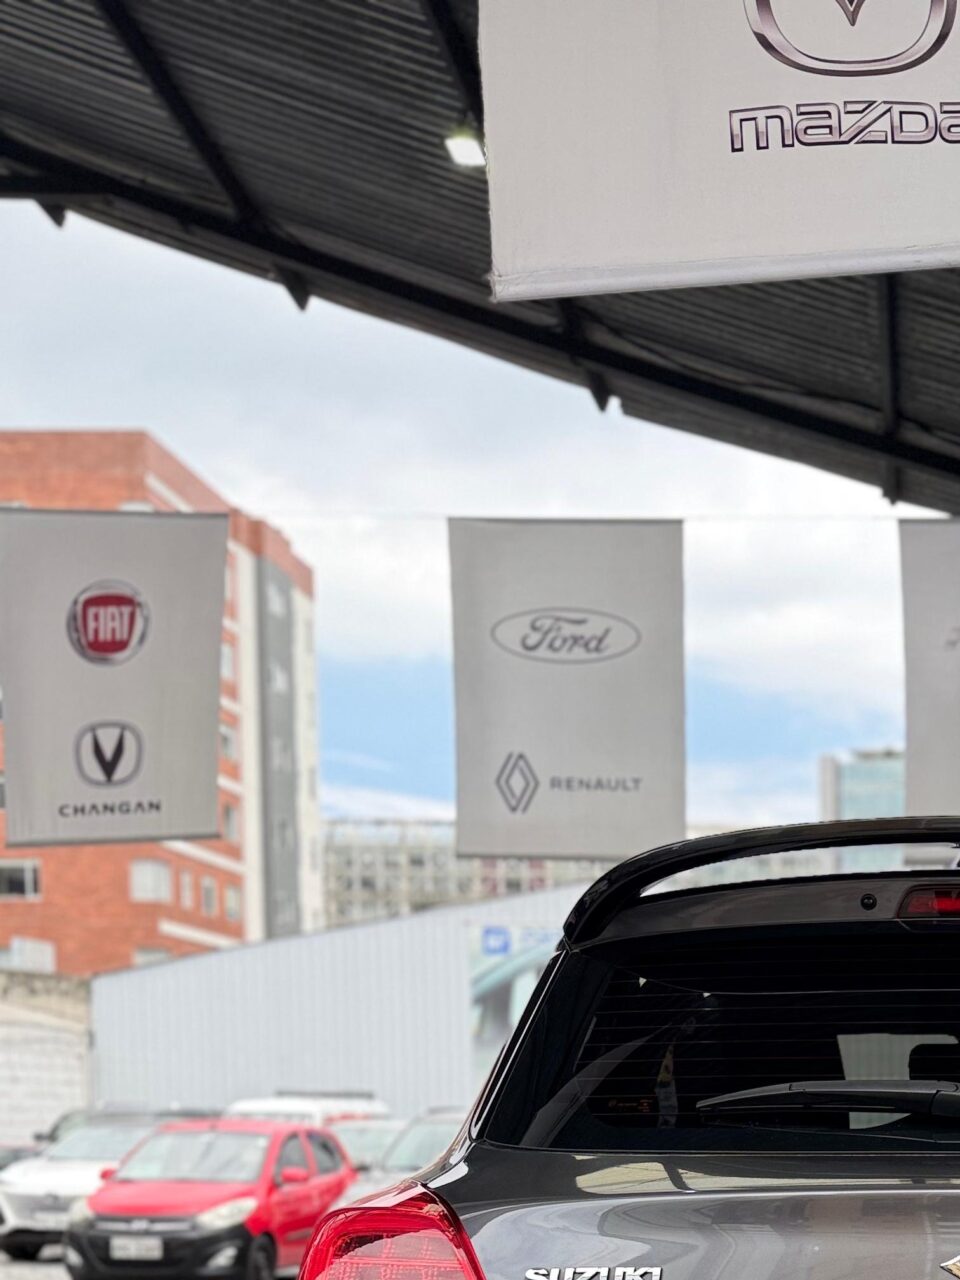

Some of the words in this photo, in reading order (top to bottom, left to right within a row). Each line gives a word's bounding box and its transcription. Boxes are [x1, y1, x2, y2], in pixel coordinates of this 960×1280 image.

[86, 604, 134, 642] FIAT
[520, 614, 612, 653] Ford
[549, 775, 643, 792] RENAULT
[58, 800, 162, 818] CHANGAN
